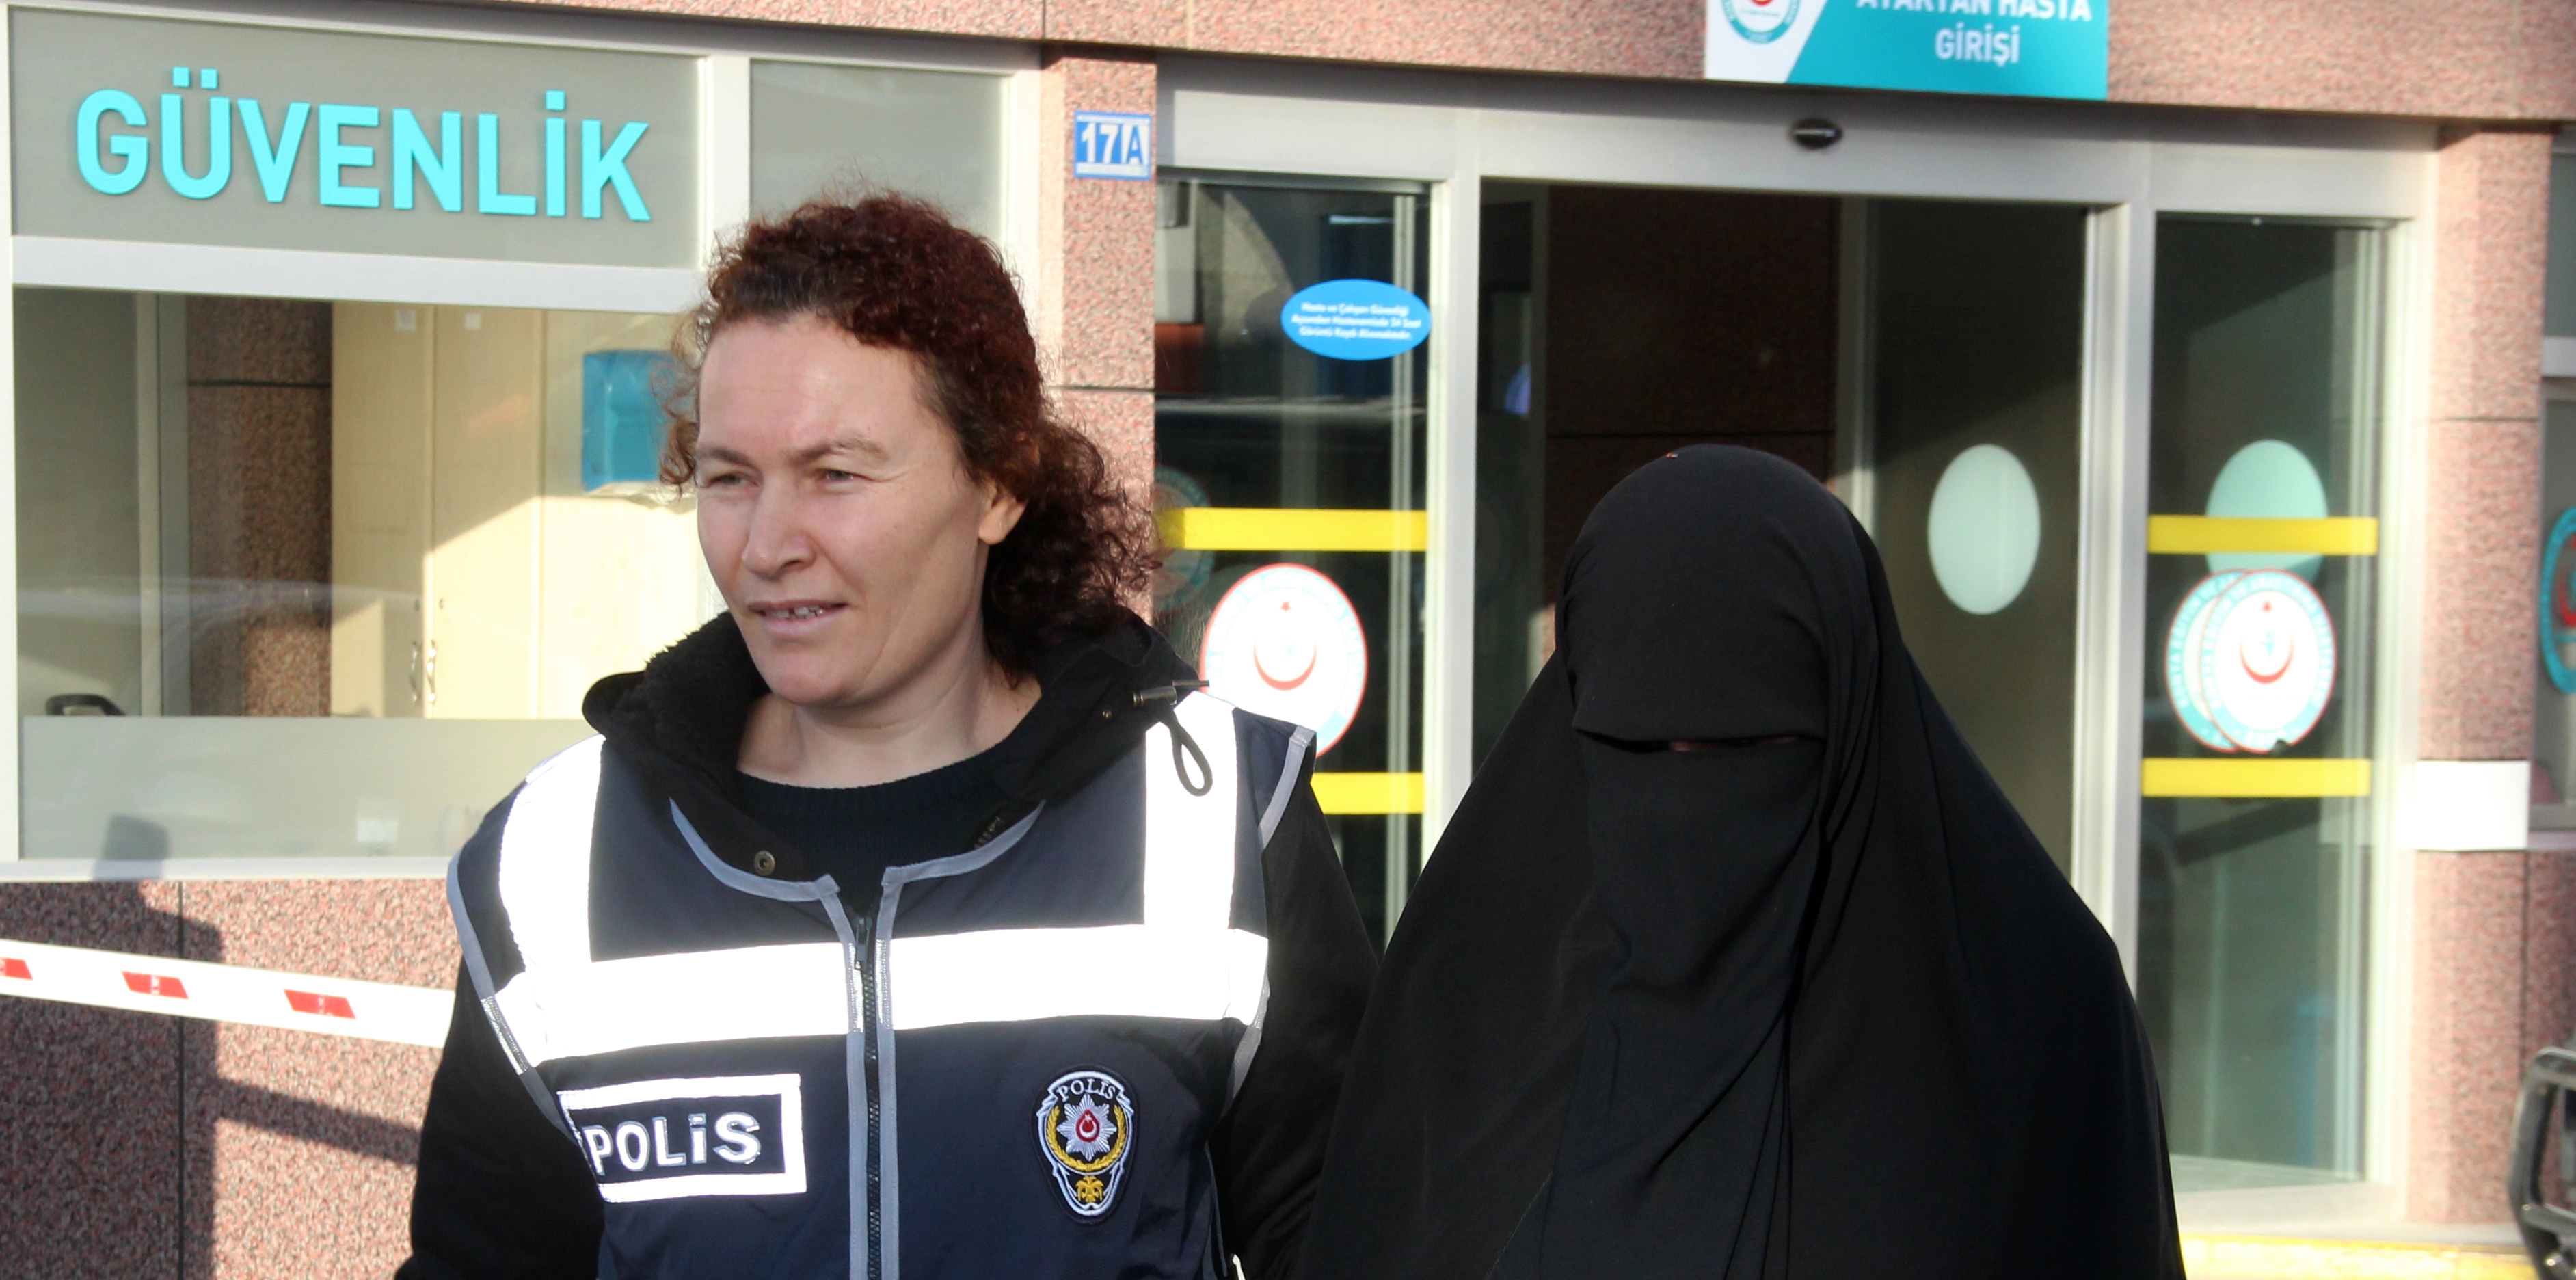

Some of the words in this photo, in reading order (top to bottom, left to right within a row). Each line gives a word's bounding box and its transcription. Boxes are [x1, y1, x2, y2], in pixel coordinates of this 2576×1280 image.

[1935, 21, 2020, 67] GİRİŞİ
[76, 66, 652, 222] GÜVENLİK
[1081, 122, 1150, 165] 17A
[1056, 1078, 1116, 1102] POLİS
